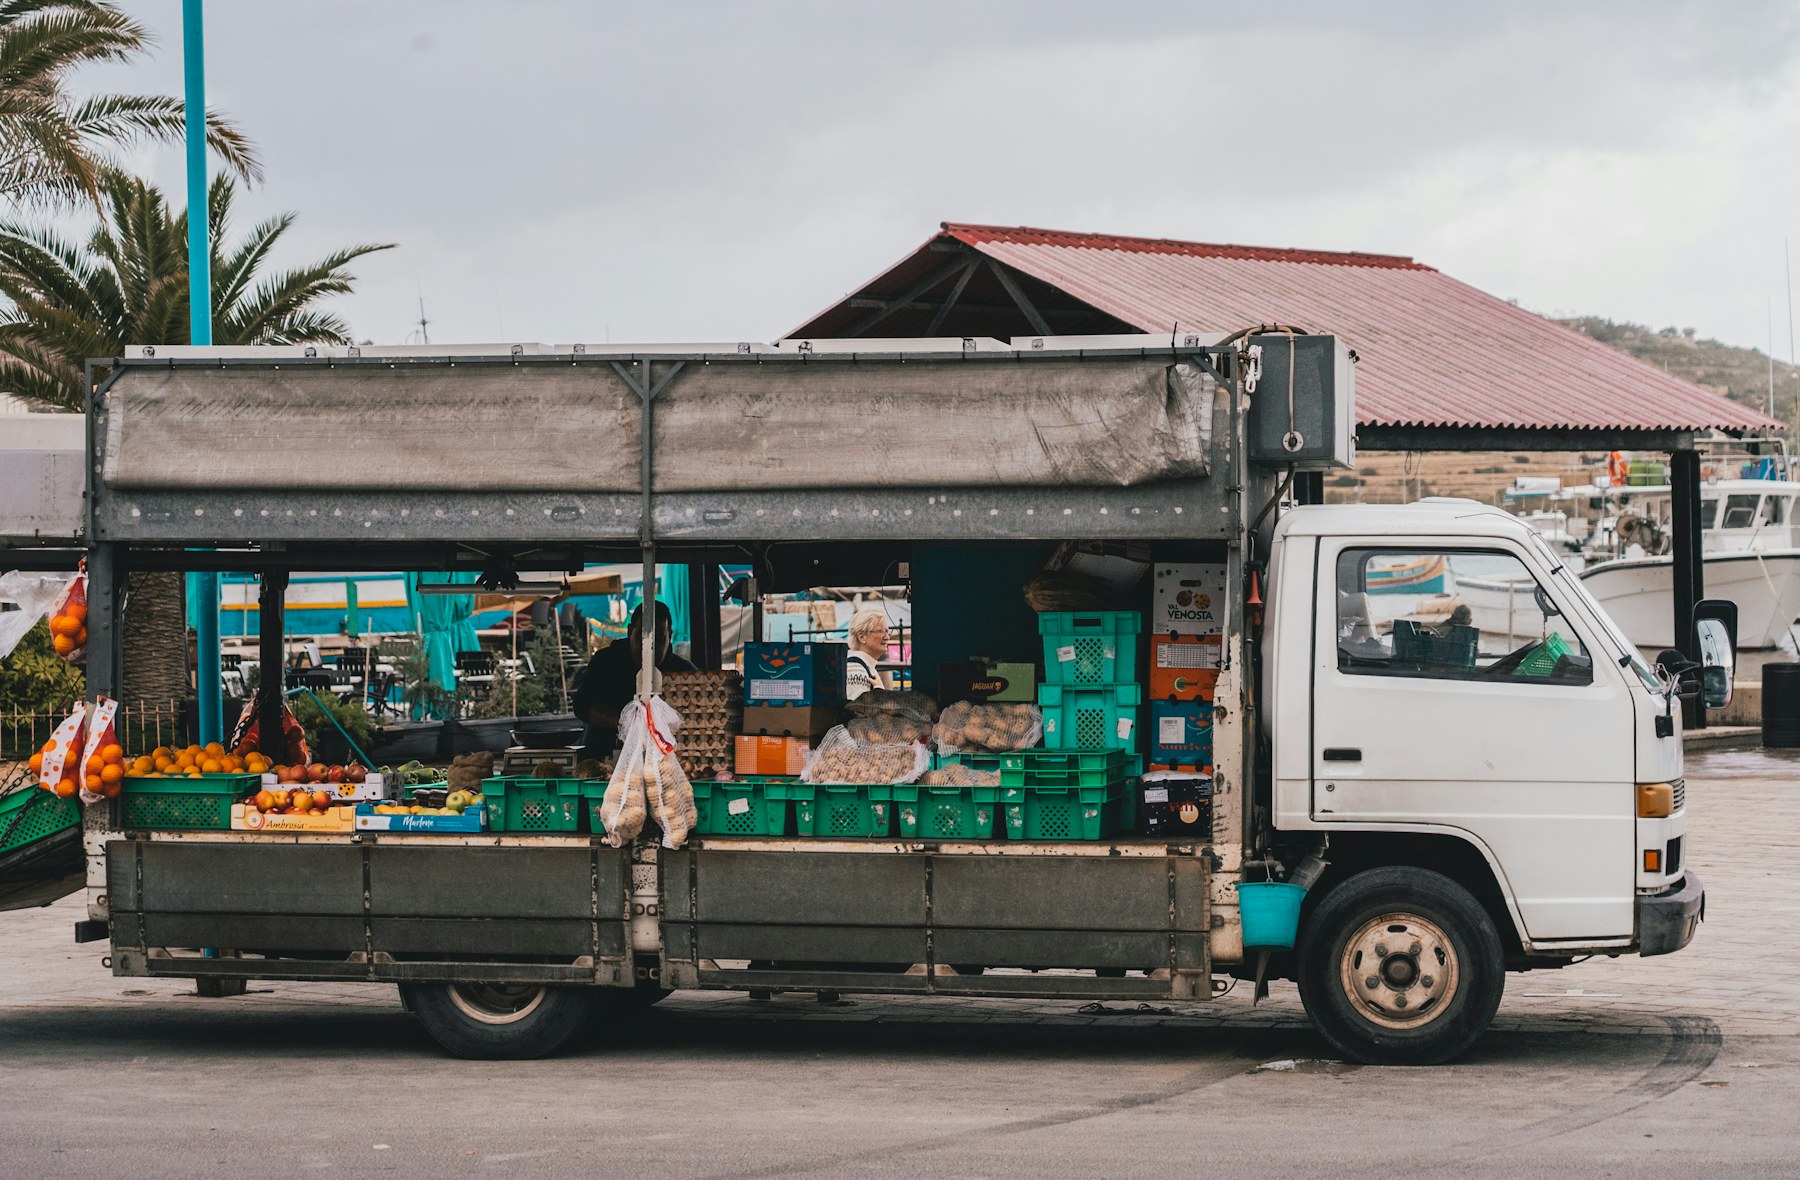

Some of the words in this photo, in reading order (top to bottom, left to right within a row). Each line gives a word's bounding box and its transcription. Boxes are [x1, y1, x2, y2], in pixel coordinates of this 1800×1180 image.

[1167, 610, 1213, 620] VENOSTA
[972, 682, 994, 691] JAGUAR
[266, 819, 304, 830] Ambrosia
[402, 816, 434, 831] Marlene
